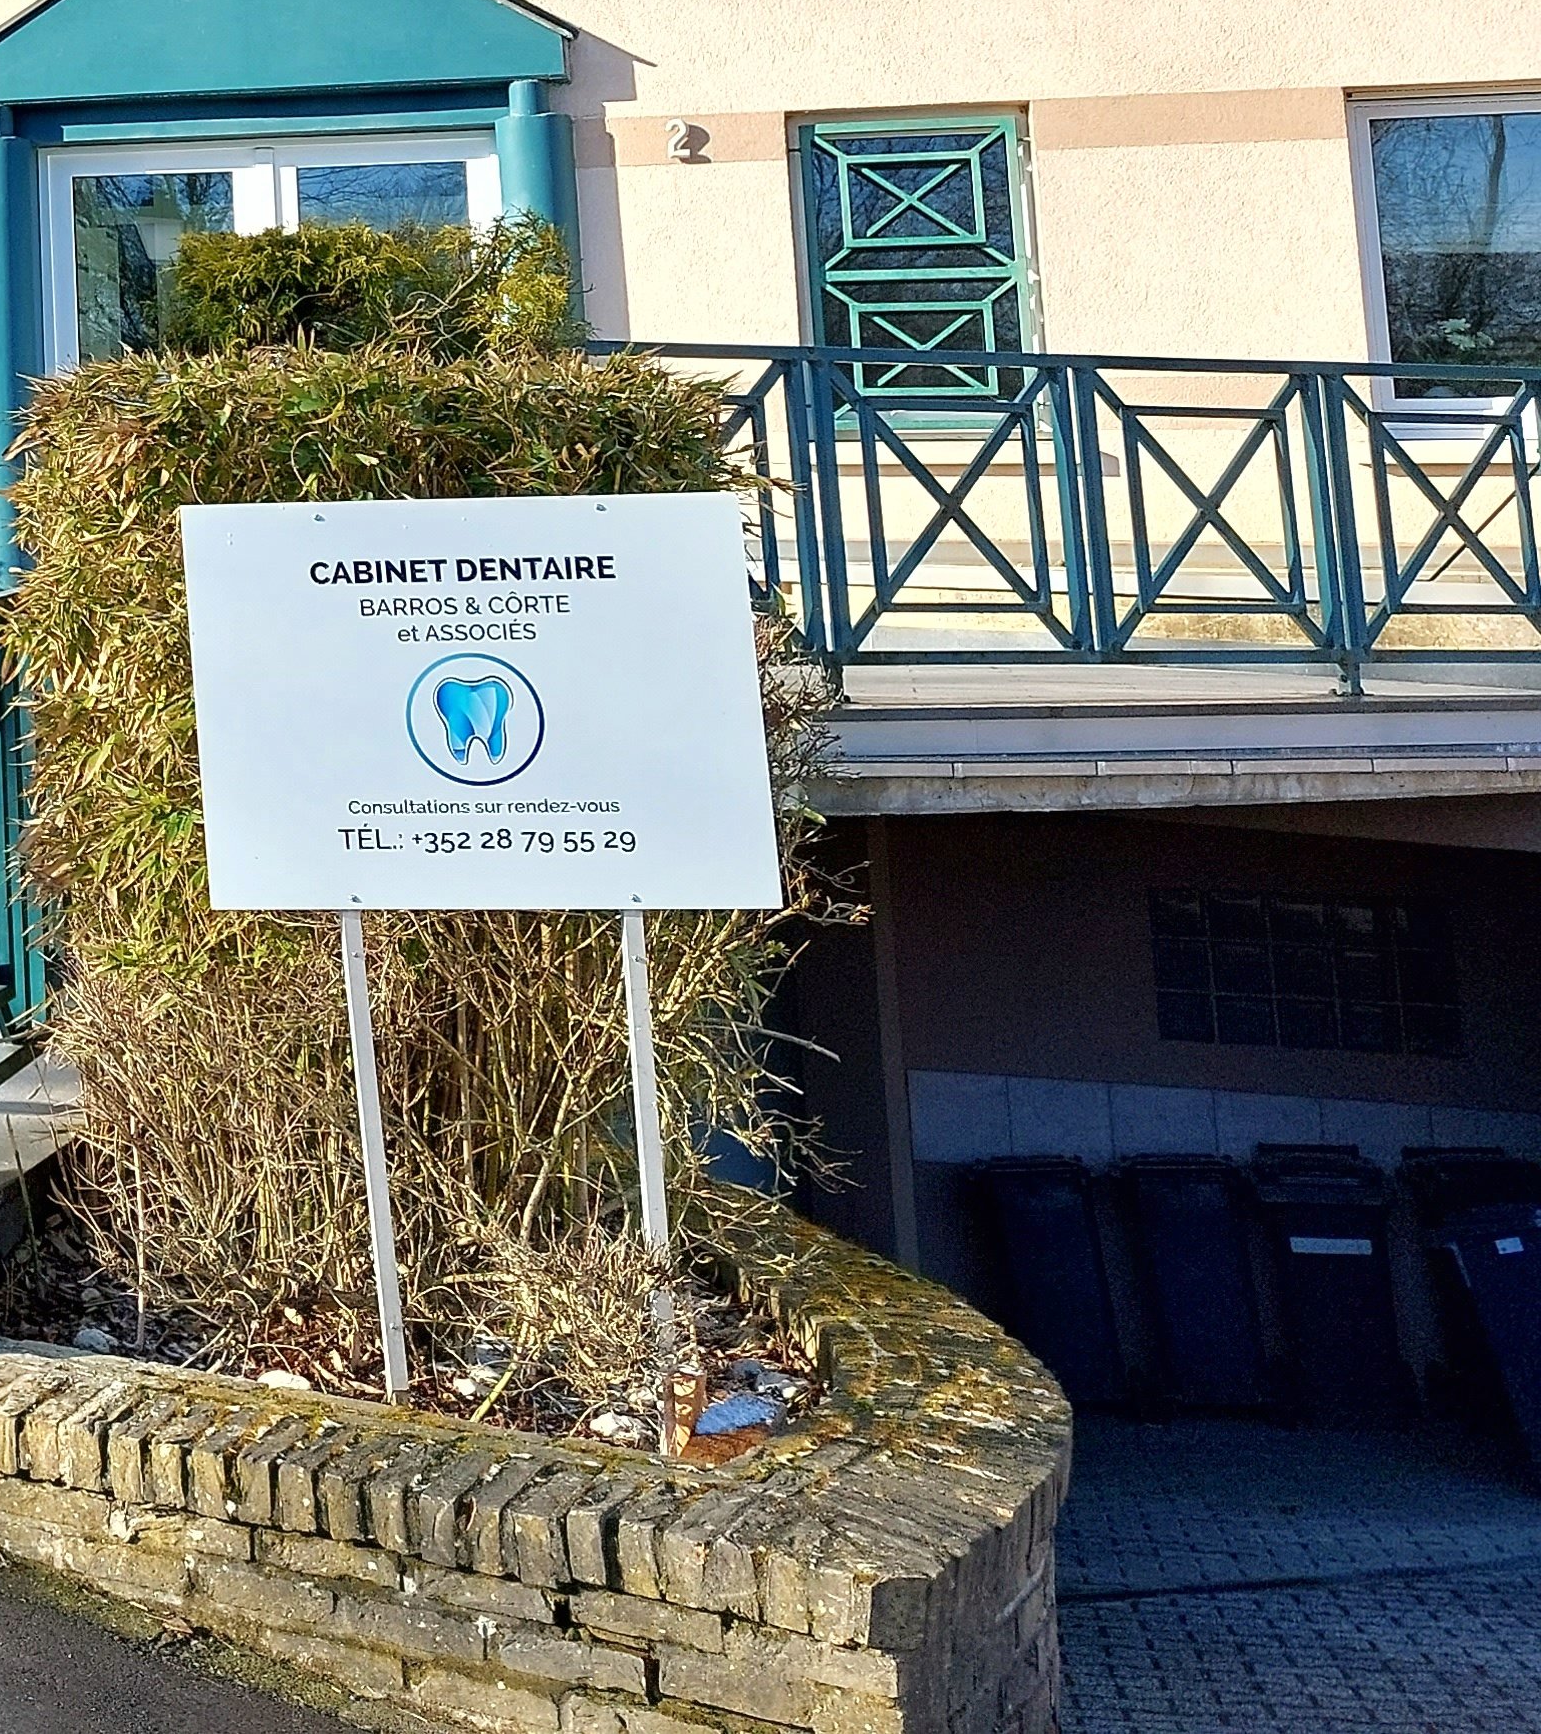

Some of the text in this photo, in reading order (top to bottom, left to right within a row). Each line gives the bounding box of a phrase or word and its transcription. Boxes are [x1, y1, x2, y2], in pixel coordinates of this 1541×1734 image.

[665, 118, 691, 159] 2
[310, 556, 616, 584] CABINET DENTAIRE
[360, 591, 571, 616] BARROS & CÔRTE
[398, 618, 537, 642] et ASSOCIÉS
[348, 798, 621, 815] Consultations sur rendez-vous
[412, 832, 472, 854] +352
[480, 828, 513, 850] 28
[521, 831, 555, 854] 79
[563, 831, 596, 853] 55
[603, 831, 637, 853] 29
